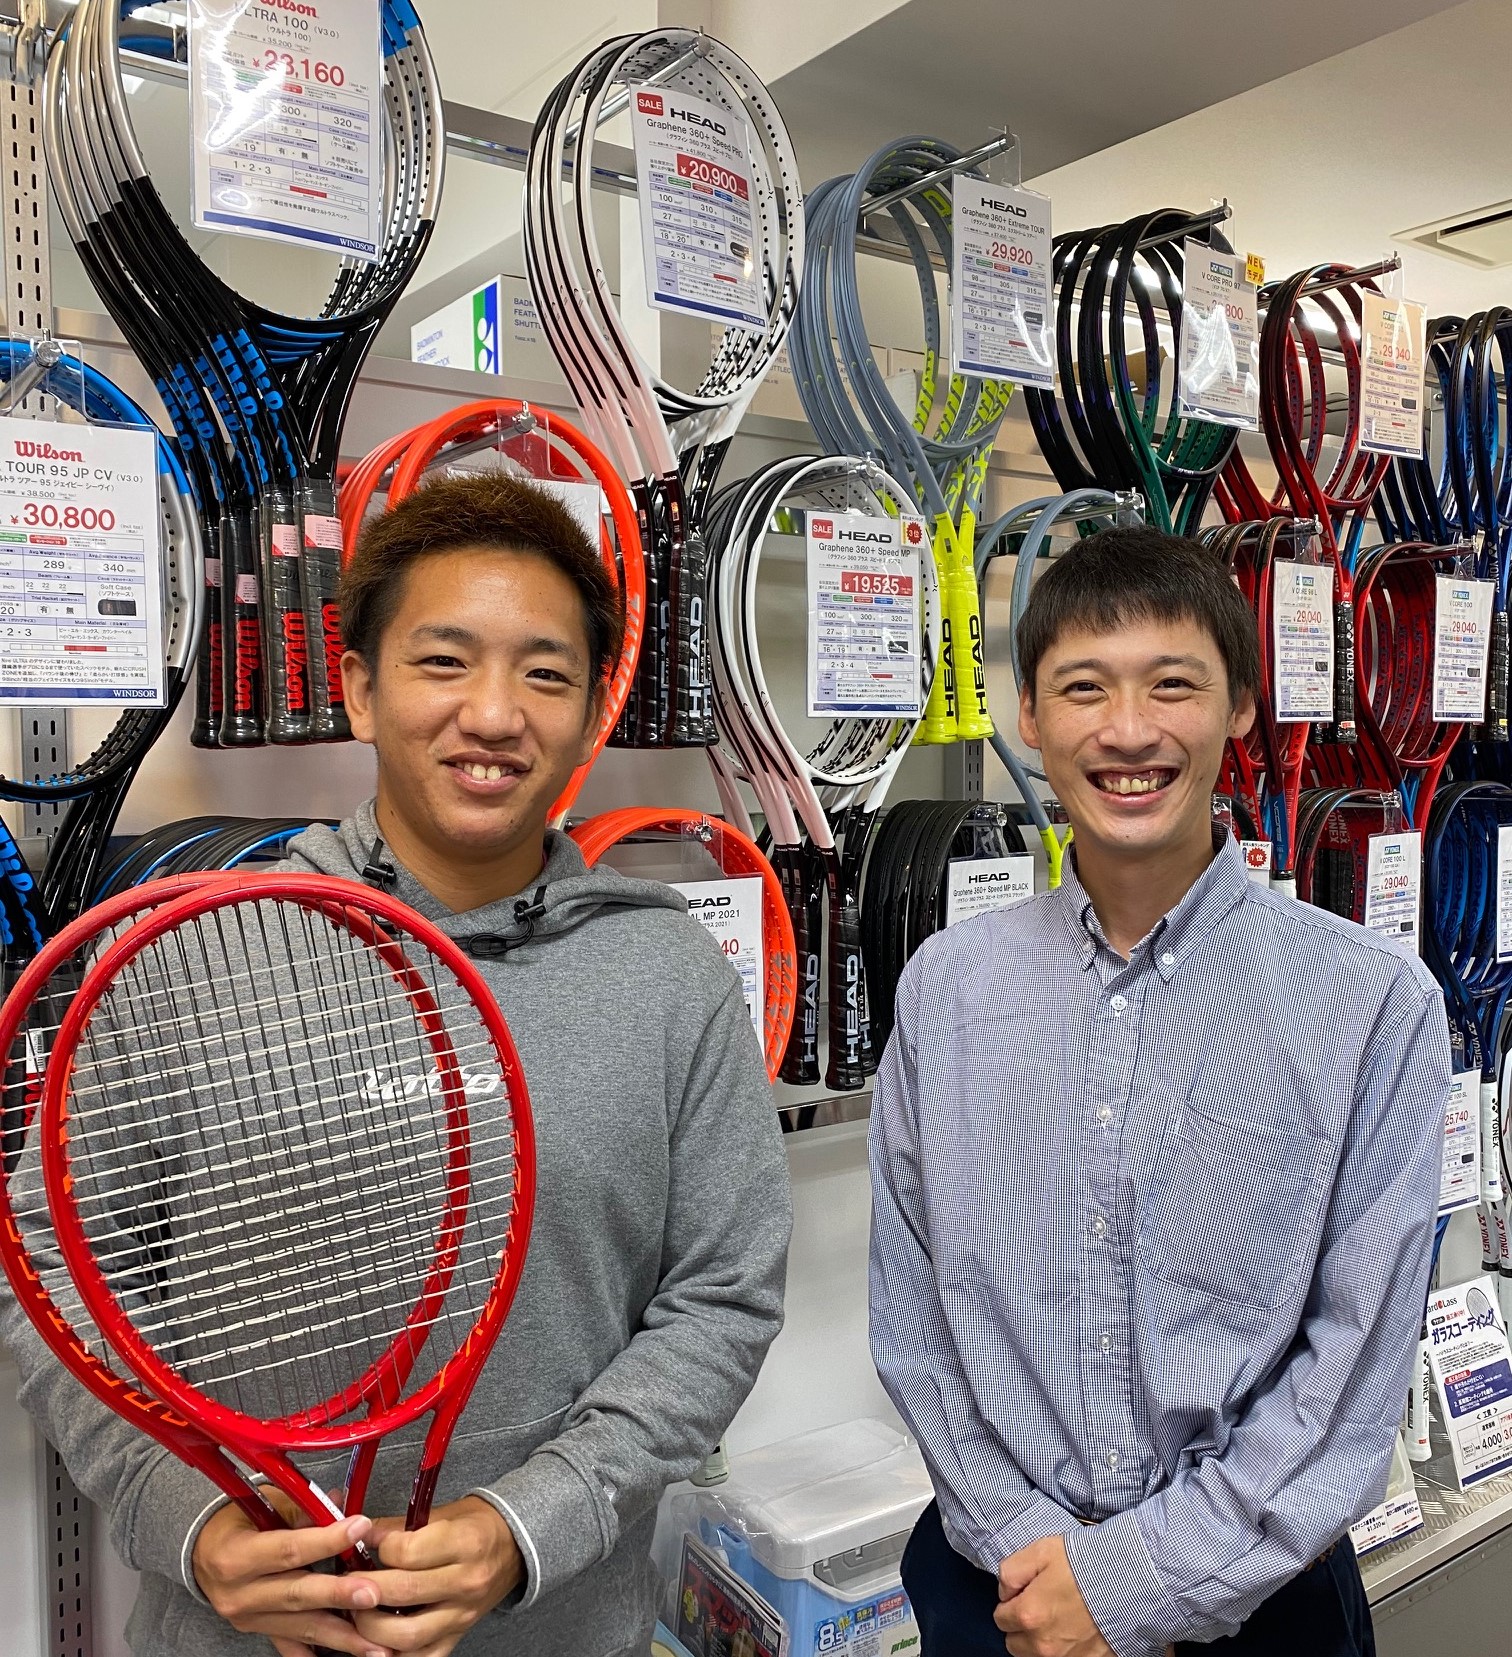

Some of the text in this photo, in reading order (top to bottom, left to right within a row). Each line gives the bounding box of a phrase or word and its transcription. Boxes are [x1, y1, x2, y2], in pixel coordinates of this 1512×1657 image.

[236, 3, 278, 23] LTRA
[284, 16, 308, 30] 100
[281, 105, 300, 116] 300
[638, 98, 662, 110] SALE
[334, 116, 352, 128] 320
[670, 108, 726, 136] HEAD
[647, 118, 743, 159] Graphene 360+ Speed PRO
[244, 143, 256, 152] 19
[690, 161, 737, 193] 20,900
[660, 194, 672, 203] 100
[701, 204, 713, 213] 310
[981, 198, 1027, 218] HEAD
[732, 215, 743, 225] 315
[962, 207, 1045, 234] Graphene 360+ Extreme TOUR
[660, 232, 668, 240] 18
[339, 238, 375, 253] WINDSOR
[992, 241, 1033, 265] 29,920
[1206, 273, 1221, 285] CORE
[1222, 276, 1233, 288] PRO
[1246, 270, 1263, 282] モデル
[1000, 281, 1010, 289] 305
[1383, 344, 1411, 361] 29040
[14, 440, 84, 462] Wilson
[5, 460, 45, 476] TOUR
[50, 464, 68, 477] 95
[73, 466, 90, 479] JP
[94, 469, 112, 481] CV
[40, 478, 51, 486] 95
[24, 503, 115, 531] 30,800
[813, 525, 832, 533] SALE
[839, 530, 892, 543] HEAD
[819, 543, 910, 557] Graphene 360+ Speed MP
[43, 560, 65, 569] 289
[103, 564, 124, 572] 340
[853, 576, 900, 594] 19,525
[1296, 610, 1322, 624] 29,040
[235, 618, 259, 712] Wilson
[283, 612, 307, 711] Wilson
[689, 597, 702, 718] HEAD
[969, 614, 987, 714] HEAD
[1346, 646, 1354, 682] YONEX
[942, 618, 954, 717] HEAD
[112, 690, 156, 698] WINDSOR
[968, 873, 1009, 883] HEAD
[1384, 876, 1408, 890] 29,040
[953, 888, 973, 897] Graphene
[988, 885, 1002, 893] Speed
[1003, 884, 1011, 892] MP
[688, 896, 731, 908] EAD
[703, 912, 716, 920] MP
[719, 909, 740, 919] 2021
[804, 954, 818, 1062] HEAD
[847, 954, 858, 1063] HEAD
[1491, 1117, 1500, 1148] YONEX
[1432, 1308, 1494, 1345] ガラスコーティング
[1422, 1370, 1430, 1404] YONEX
[1482, 1433, 1502, 1450] 4,000
[891, 1636, 918, 1655] prince
